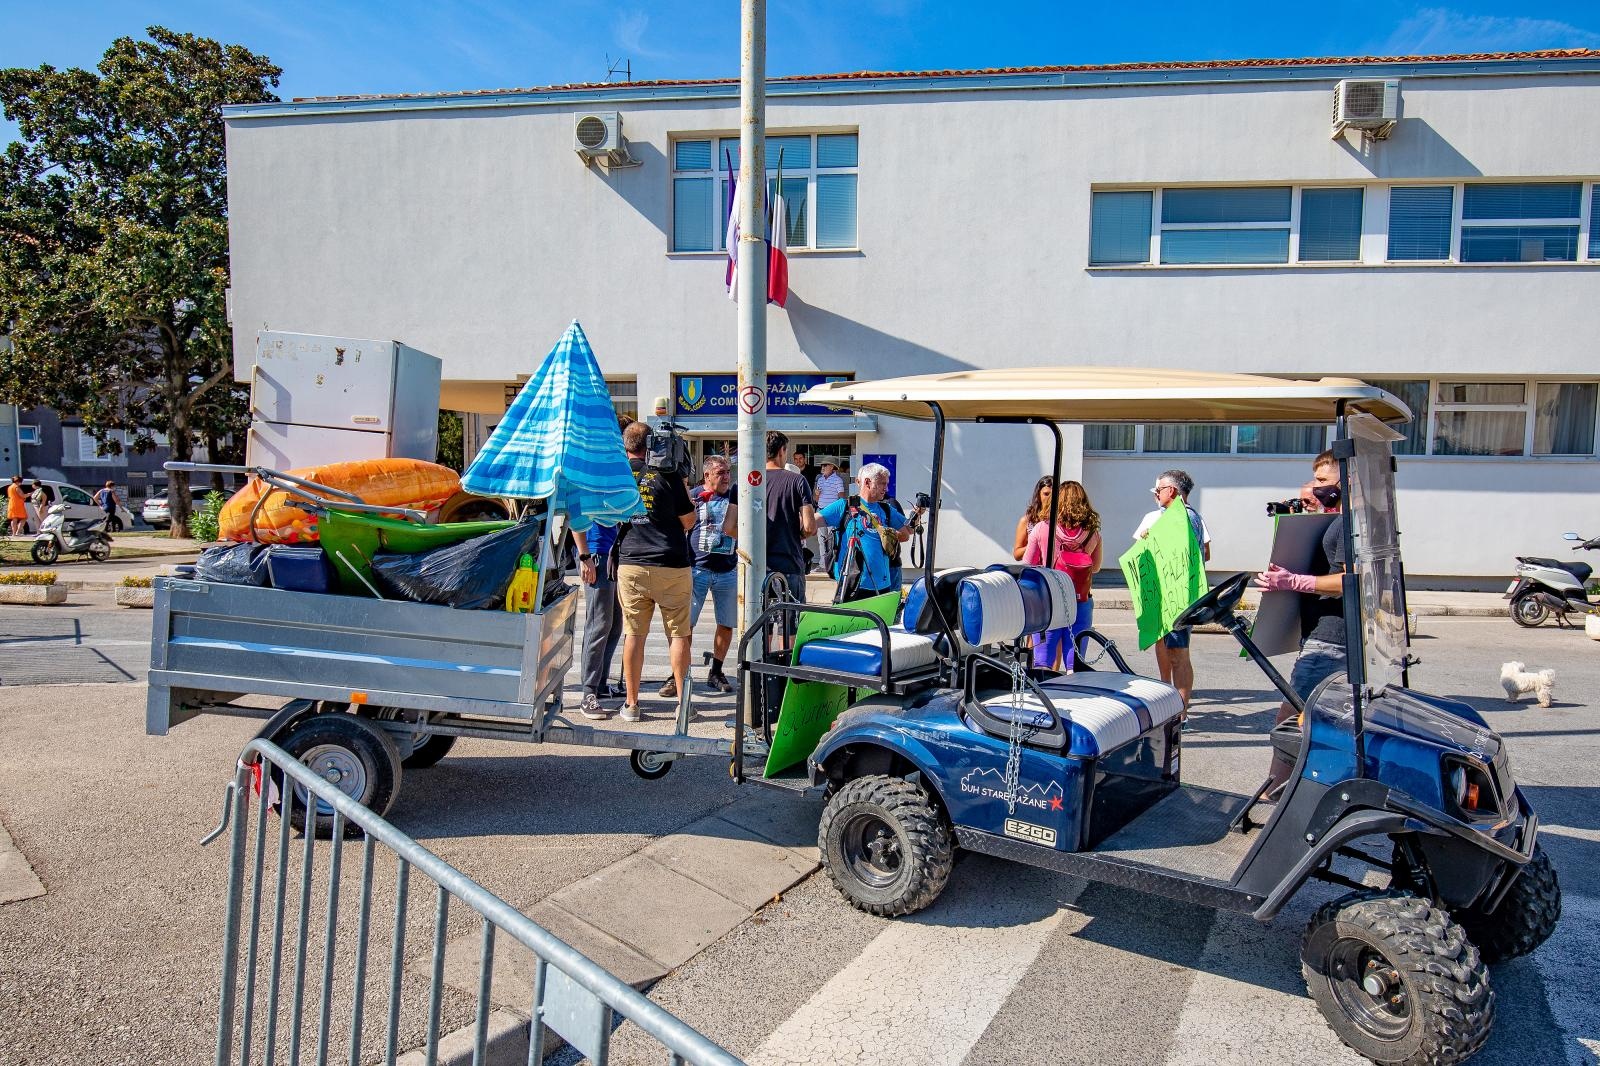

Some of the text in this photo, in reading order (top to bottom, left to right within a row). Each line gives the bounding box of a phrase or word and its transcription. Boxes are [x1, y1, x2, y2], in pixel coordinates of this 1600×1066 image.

[961, 783, 980, 794] DUH
[981, 788, 1010, 801] STARE
[1007, 820, 1055, 842] EZGO
